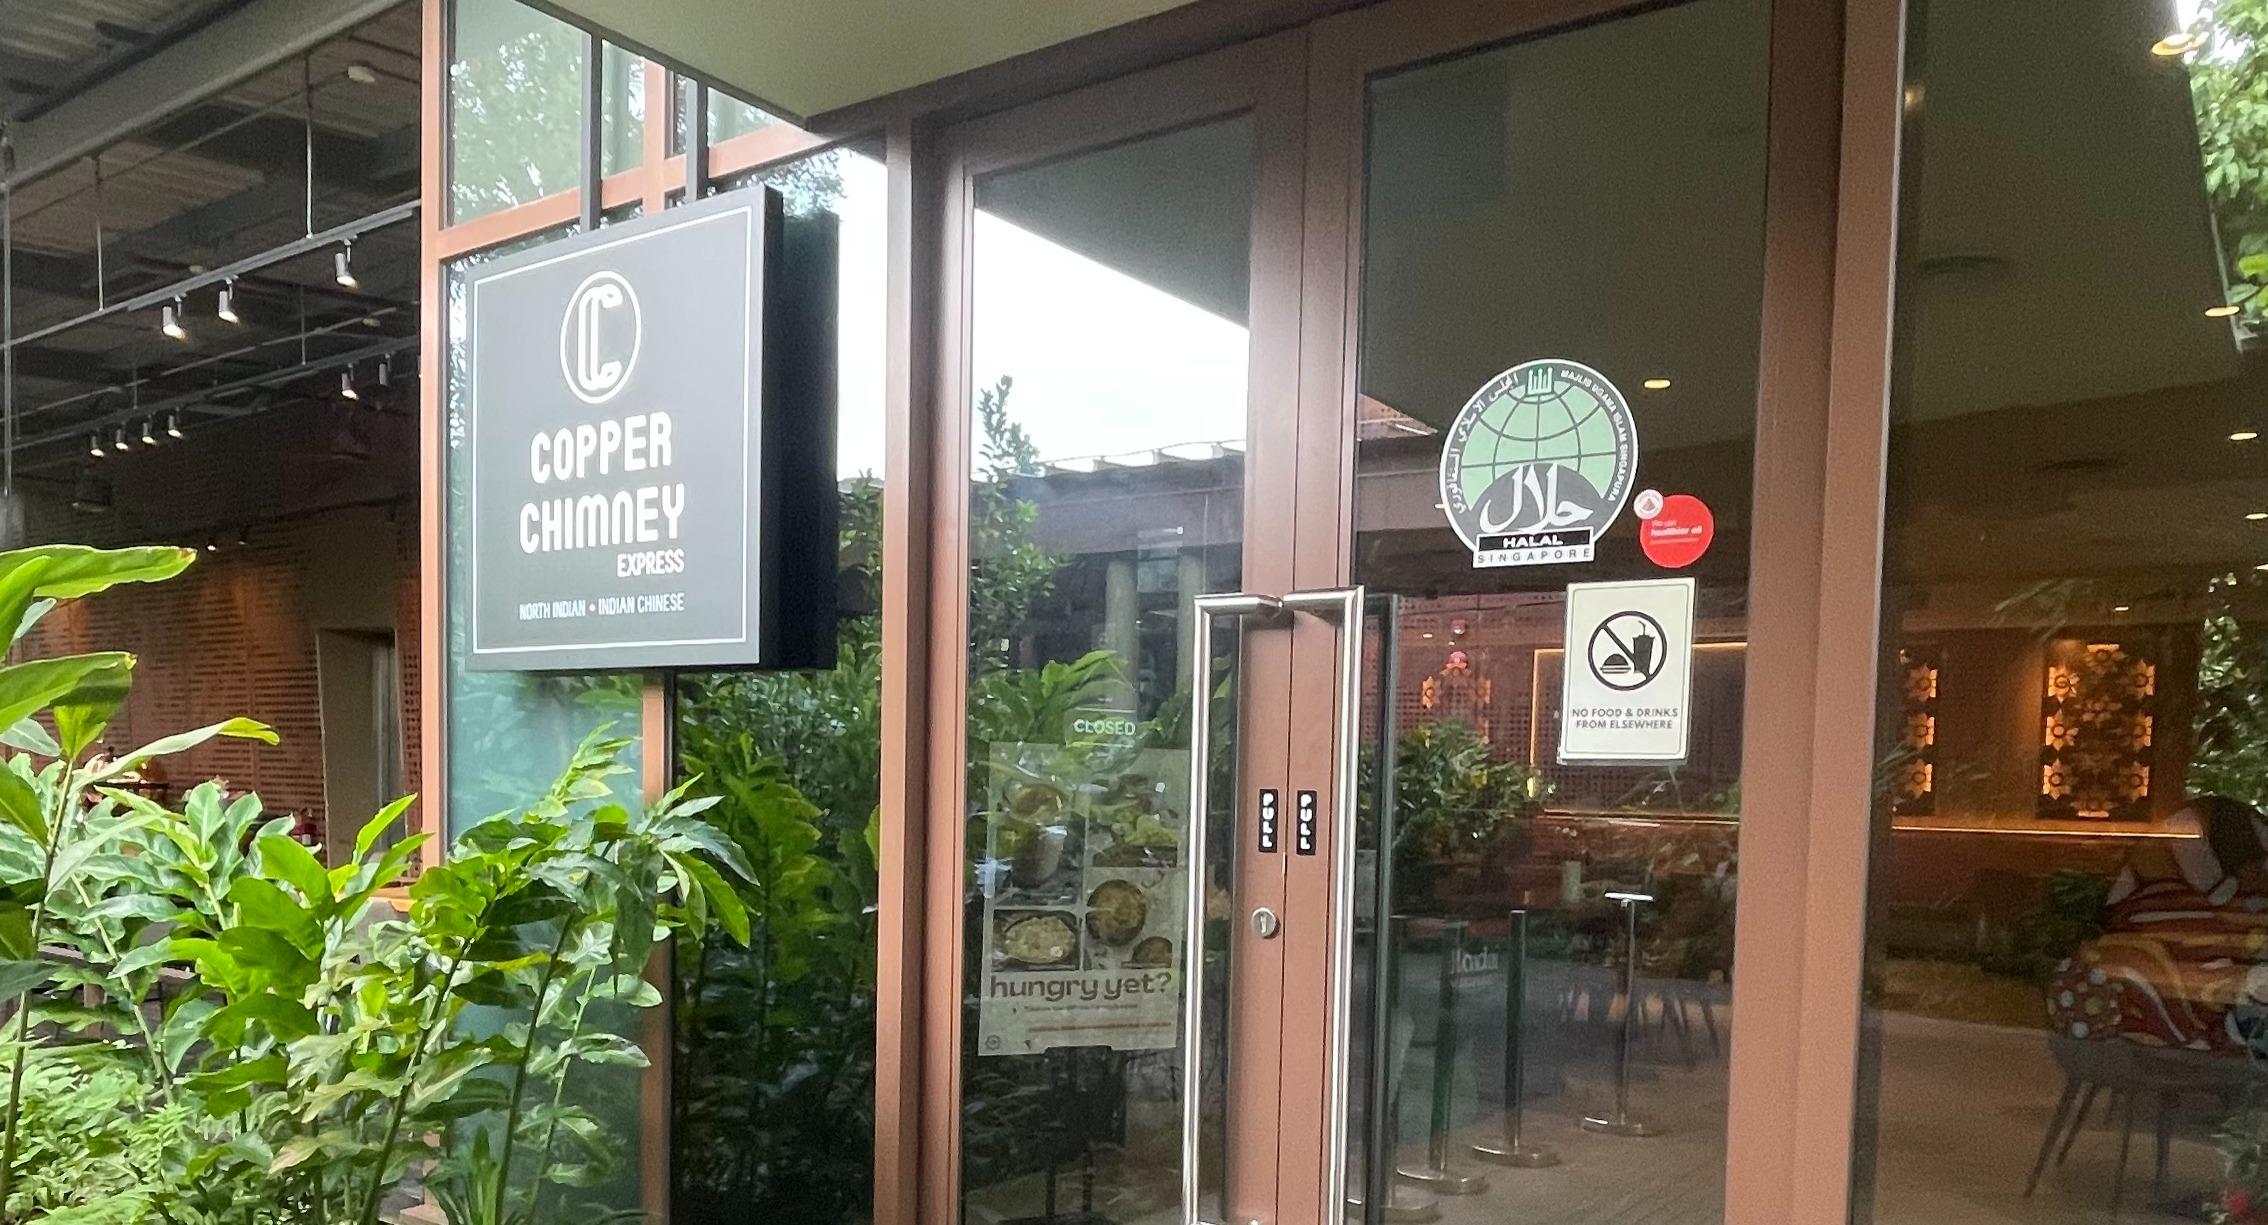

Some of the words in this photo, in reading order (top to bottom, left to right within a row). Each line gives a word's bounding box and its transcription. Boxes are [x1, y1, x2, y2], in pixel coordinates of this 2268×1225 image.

[1561, 370, 1592, 388] MAJLIS
[1592, 384, 1617, 413] UGAMA
[1613, 412, 1628, 442] ISLAM
[530, 411, 672, 484] COPPER
[1479, 463, 1594, 533] حلال
[519, 482, 685, 555] CHIMNEY
[1477, 548, 1591, 564] SINGAPORE
[1502, 534, 1564, 549] HALAL
[616, 549, 685, 577] EXPRESS
[519, 602, 551, 621] NORTH
[552, 600, 586, 617] INDIAN
[598, 596, 635, 615] INDIAN
[637, 593, 685, 614] CHINESE
[1073, 717, 1136, 736] CLOSED
[1571, 707, 1589, 718] NO
[1591, 707, 1623, 717] FOOD
[1624, 707, 1634, 717] &
[1636, 707, 1679, 717] DRINKS
[1575, 719, 1607, 729] FROM
[1609, 719, 1673, 729] ELSEWHERE
[1262, 792, 1275, 848] PULL
[1299, 794, 1313, 850] PULL
[990, 975, 1099, 1002] hungry
[1103, 972, 1172, 1000] yet?
